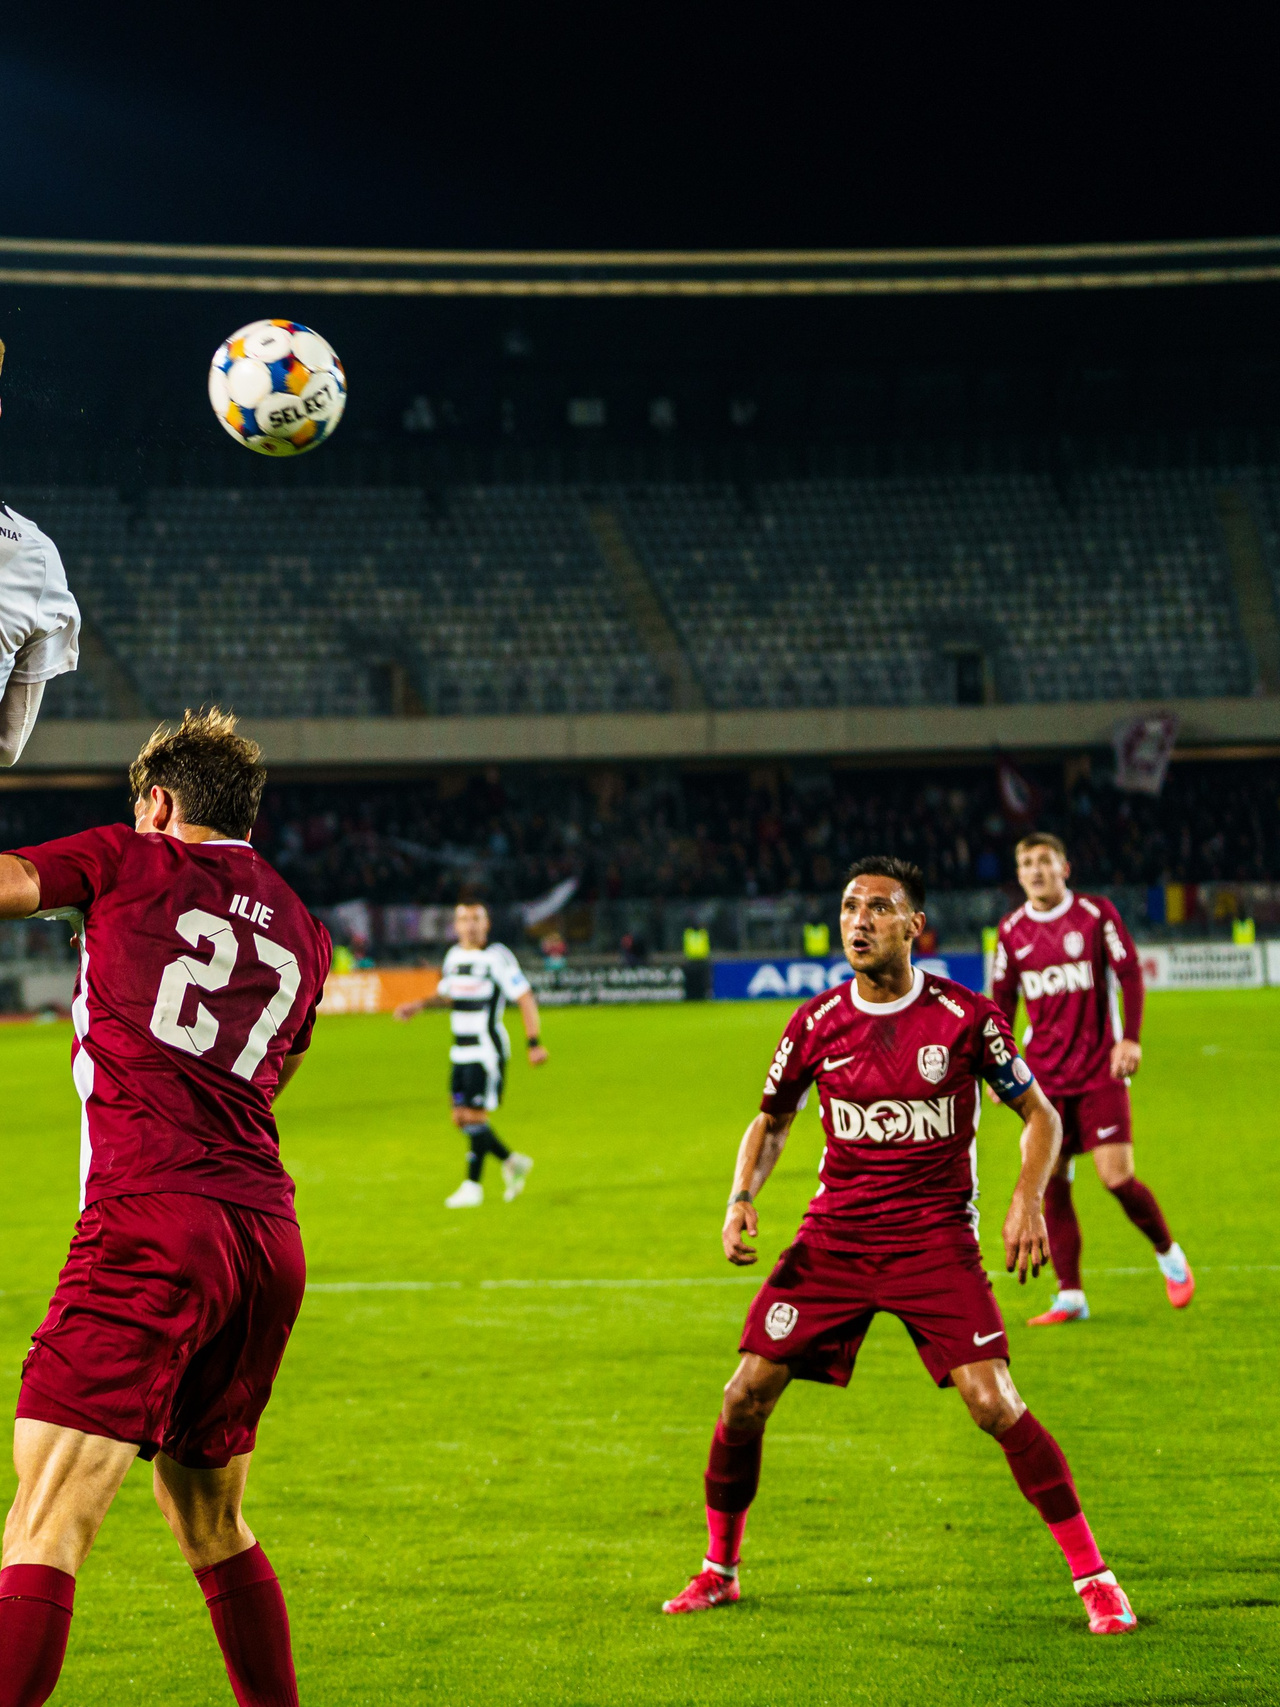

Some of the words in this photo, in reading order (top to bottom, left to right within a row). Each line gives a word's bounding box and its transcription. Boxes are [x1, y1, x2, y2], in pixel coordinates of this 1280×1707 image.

[269, 385, 333, 429] SELECT
[228, 893, 275, 929] ILIE
[149, 908, 302, 1082] 27
[1021, 960, 1095, 1001] DON
[768, 1036, 794, 1082] DSC
[989, 1035, 1012, 1067] DS
[829, 1095, 956, 1143] DON
